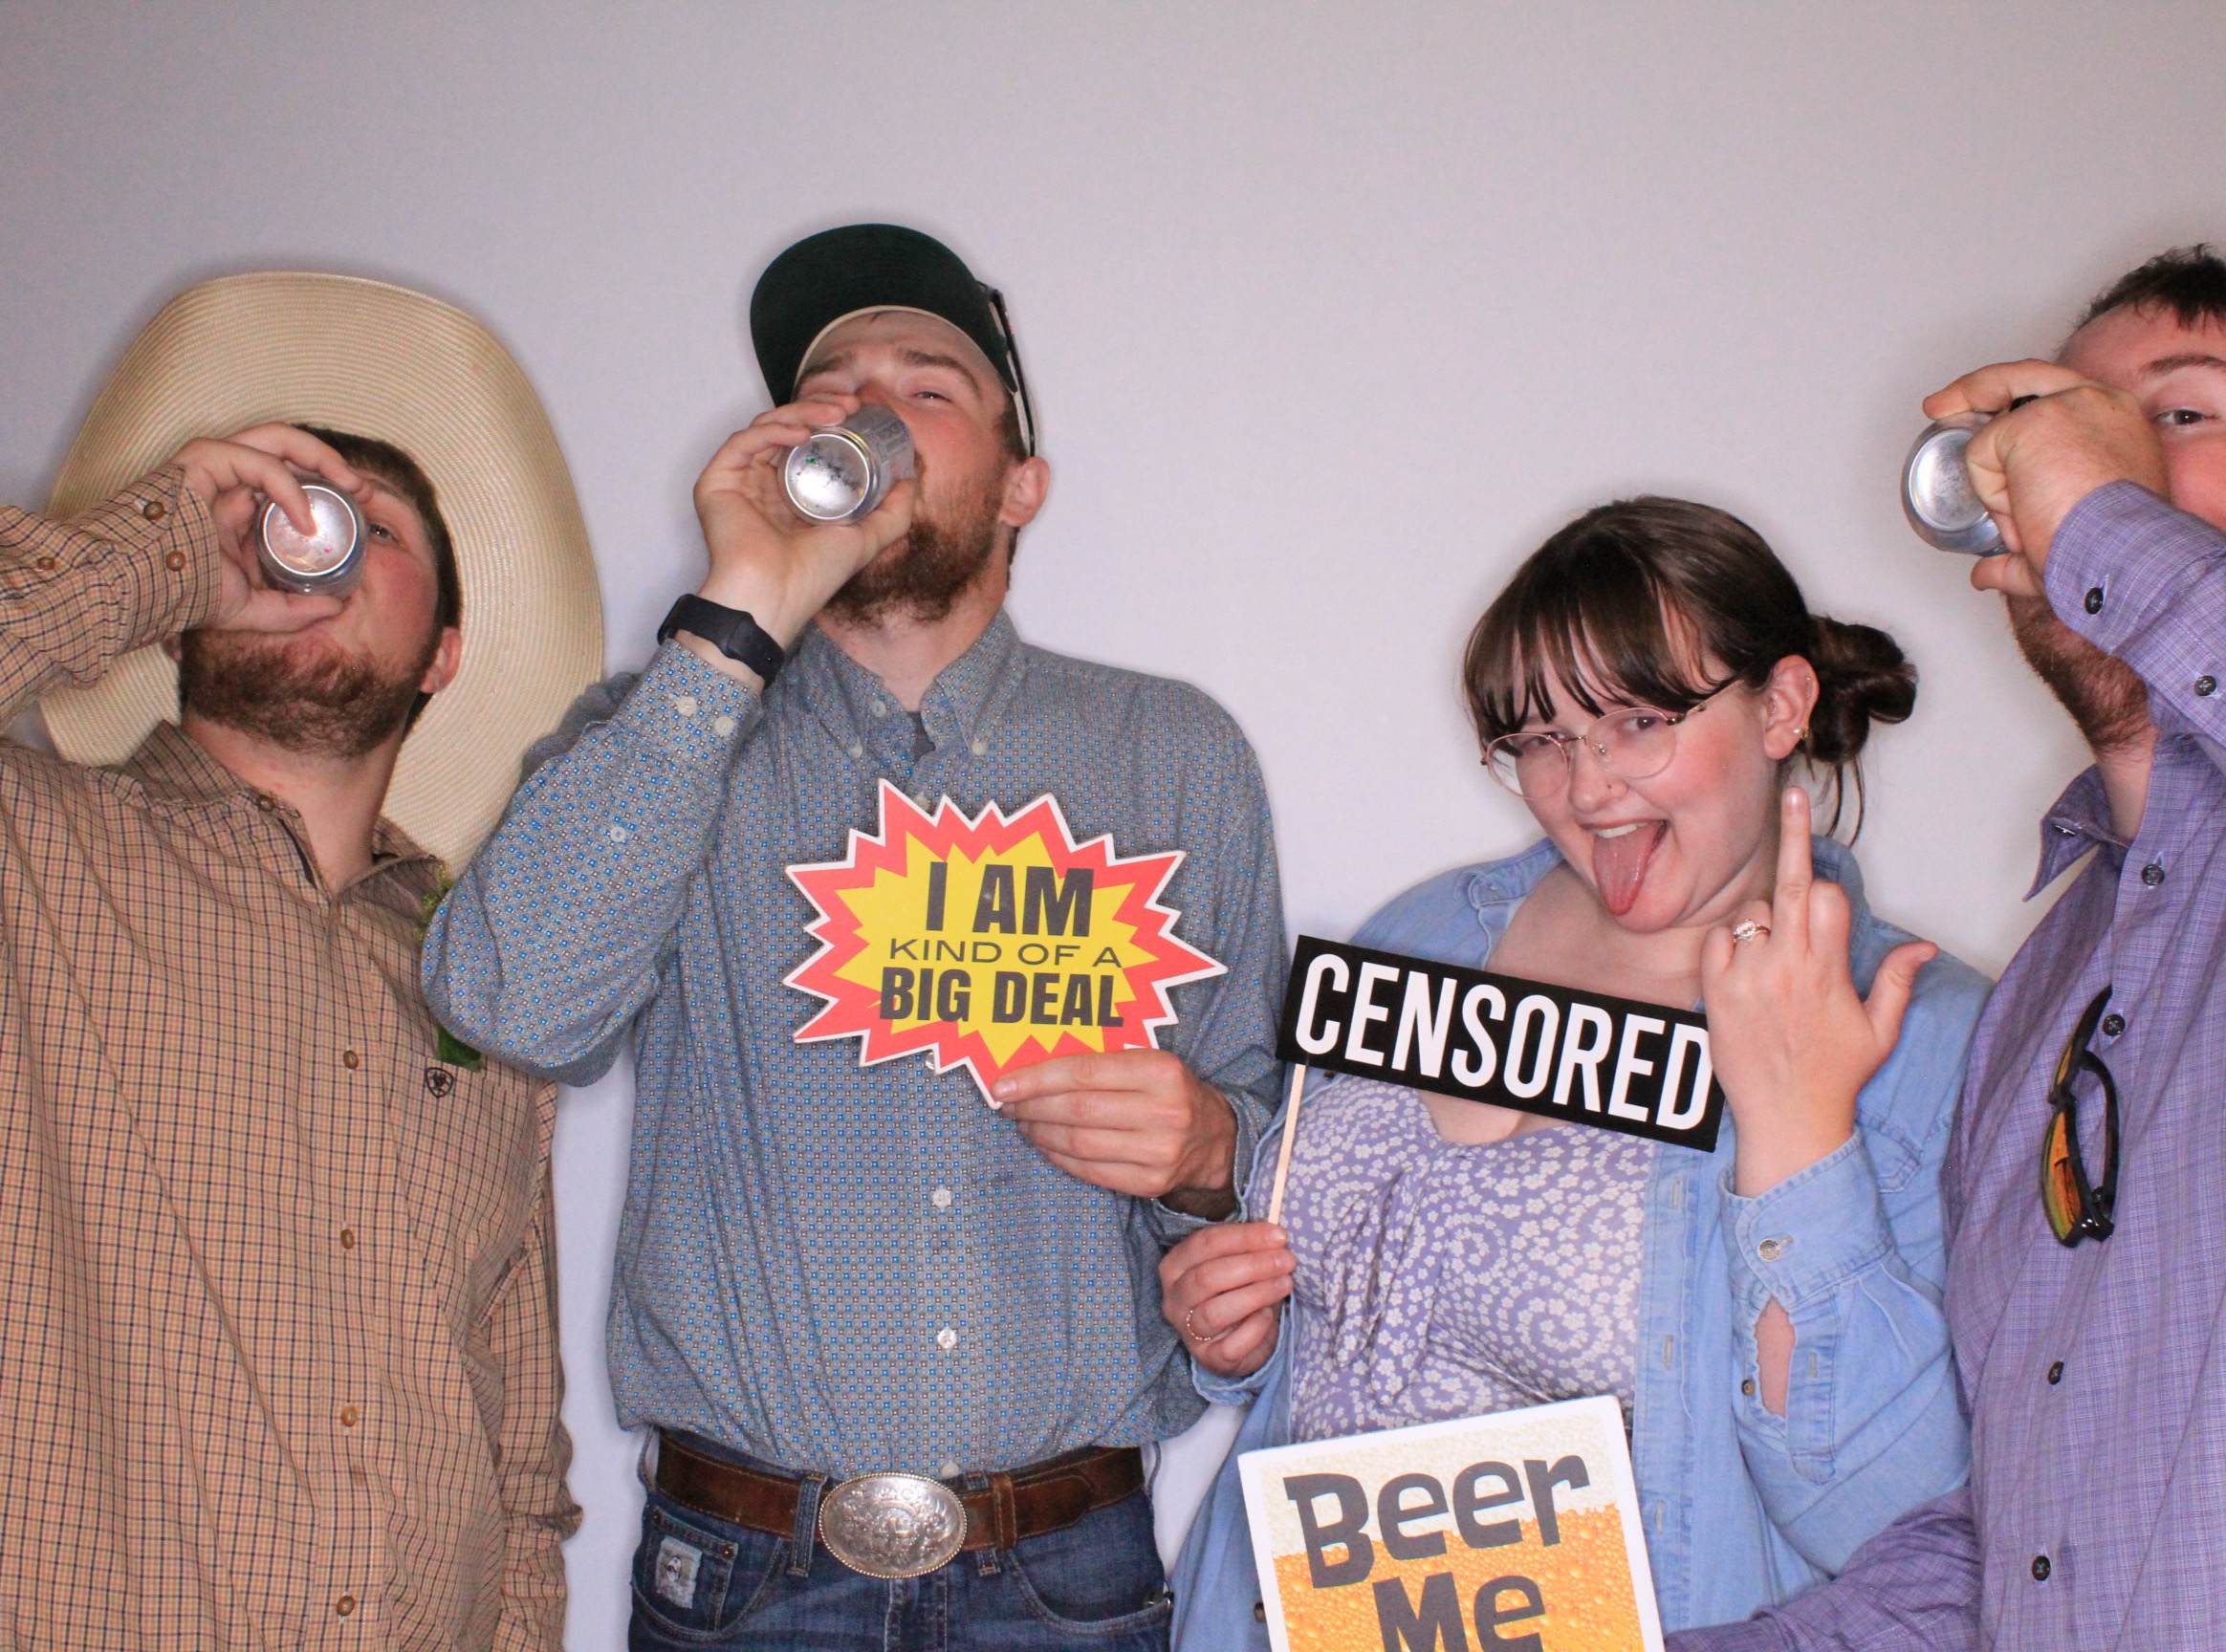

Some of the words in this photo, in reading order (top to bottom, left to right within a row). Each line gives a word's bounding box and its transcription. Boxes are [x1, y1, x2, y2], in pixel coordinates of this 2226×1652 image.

[926, 861, 948, 931] I
[971, 863, 1094, 937] AM
[889, 938, 1001, 965] KIND
[1017, 943, 1080, 966] OF
[1092, 946, 1123, 968] A
[879, 967, 971, 1023] BIG
[992, 971, 1124, 1028] DEAL
[1296, 952, 1714, 1130] CENSORED
[1282, 1454, 1590, 1589] Beer
[1371, 1571, 1546, 1652] Me
